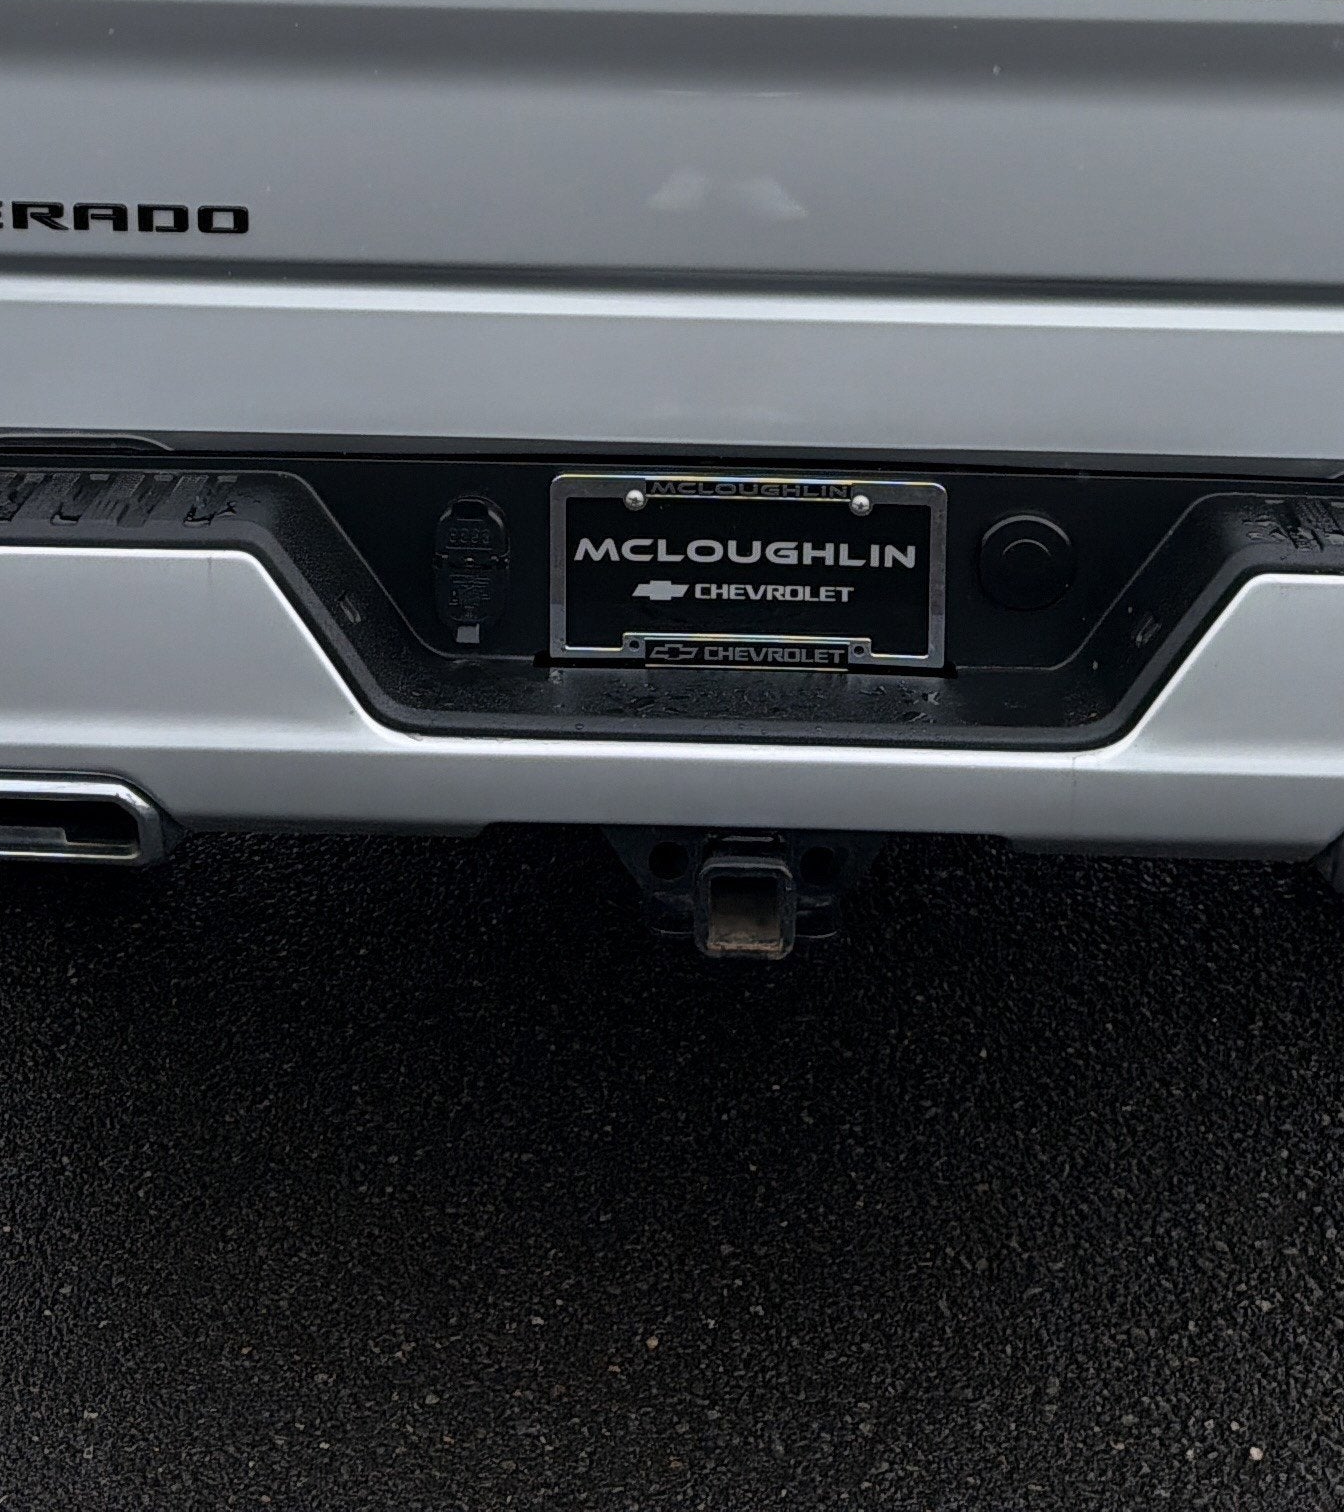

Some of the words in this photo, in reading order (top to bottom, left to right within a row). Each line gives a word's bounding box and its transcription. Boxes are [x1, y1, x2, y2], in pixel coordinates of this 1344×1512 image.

[651, 481, 848, 499] MCLOUGHLIN
[573, 537, 916, 569] MCLOUGHLIN
[694, 582, 855, 604] CHEVROLET
[704, 645, 845, 664] CHEVROLET
